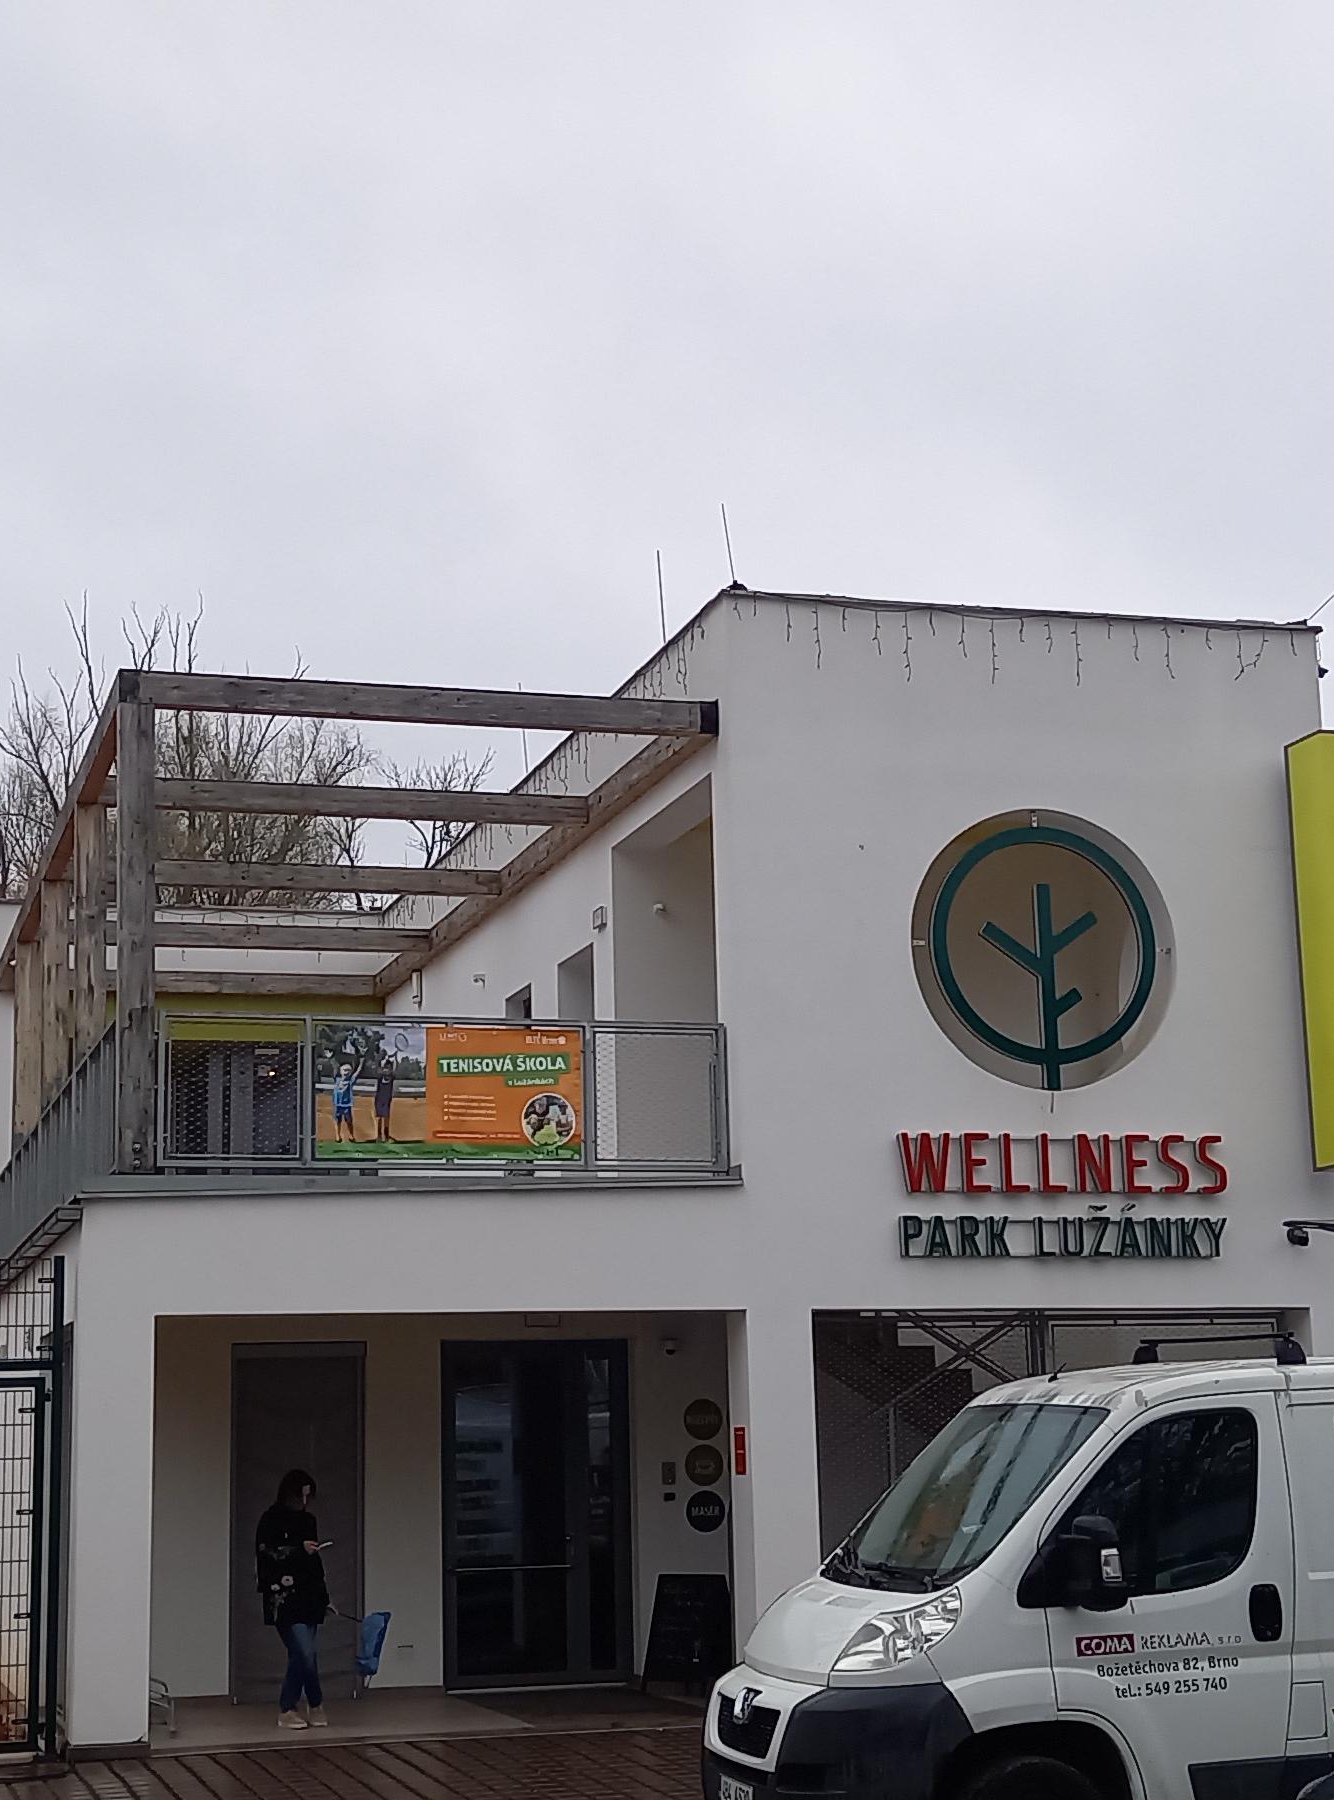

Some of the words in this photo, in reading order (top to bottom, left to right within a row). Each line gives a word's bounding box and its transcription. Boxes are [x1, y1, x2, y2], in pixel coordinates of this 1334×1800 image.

[439, 1055, 513, 1074] TENISOVÁ
[517, 1053, 566, 1072] ŠKOLA
[896, 1132, 1228, 1195] WELLNESS
[898, 1215, 1010, 1258] PARK
[1034, 1203, 1228, 1259] LUŽÁNKY
[1080, 1636, 1133, 1655] COMA
[1096, 1661, 1180, 1678] Božetěchova
[1182, 1657, 1205, 1672] 82,
[1208, 1655, 1239, 1670] Brno
[1145, 1681, 1170, 1697] 549
[1174, 1679, 1200, 1694] 255
[1203, 1676, 1228, 1692] 740
